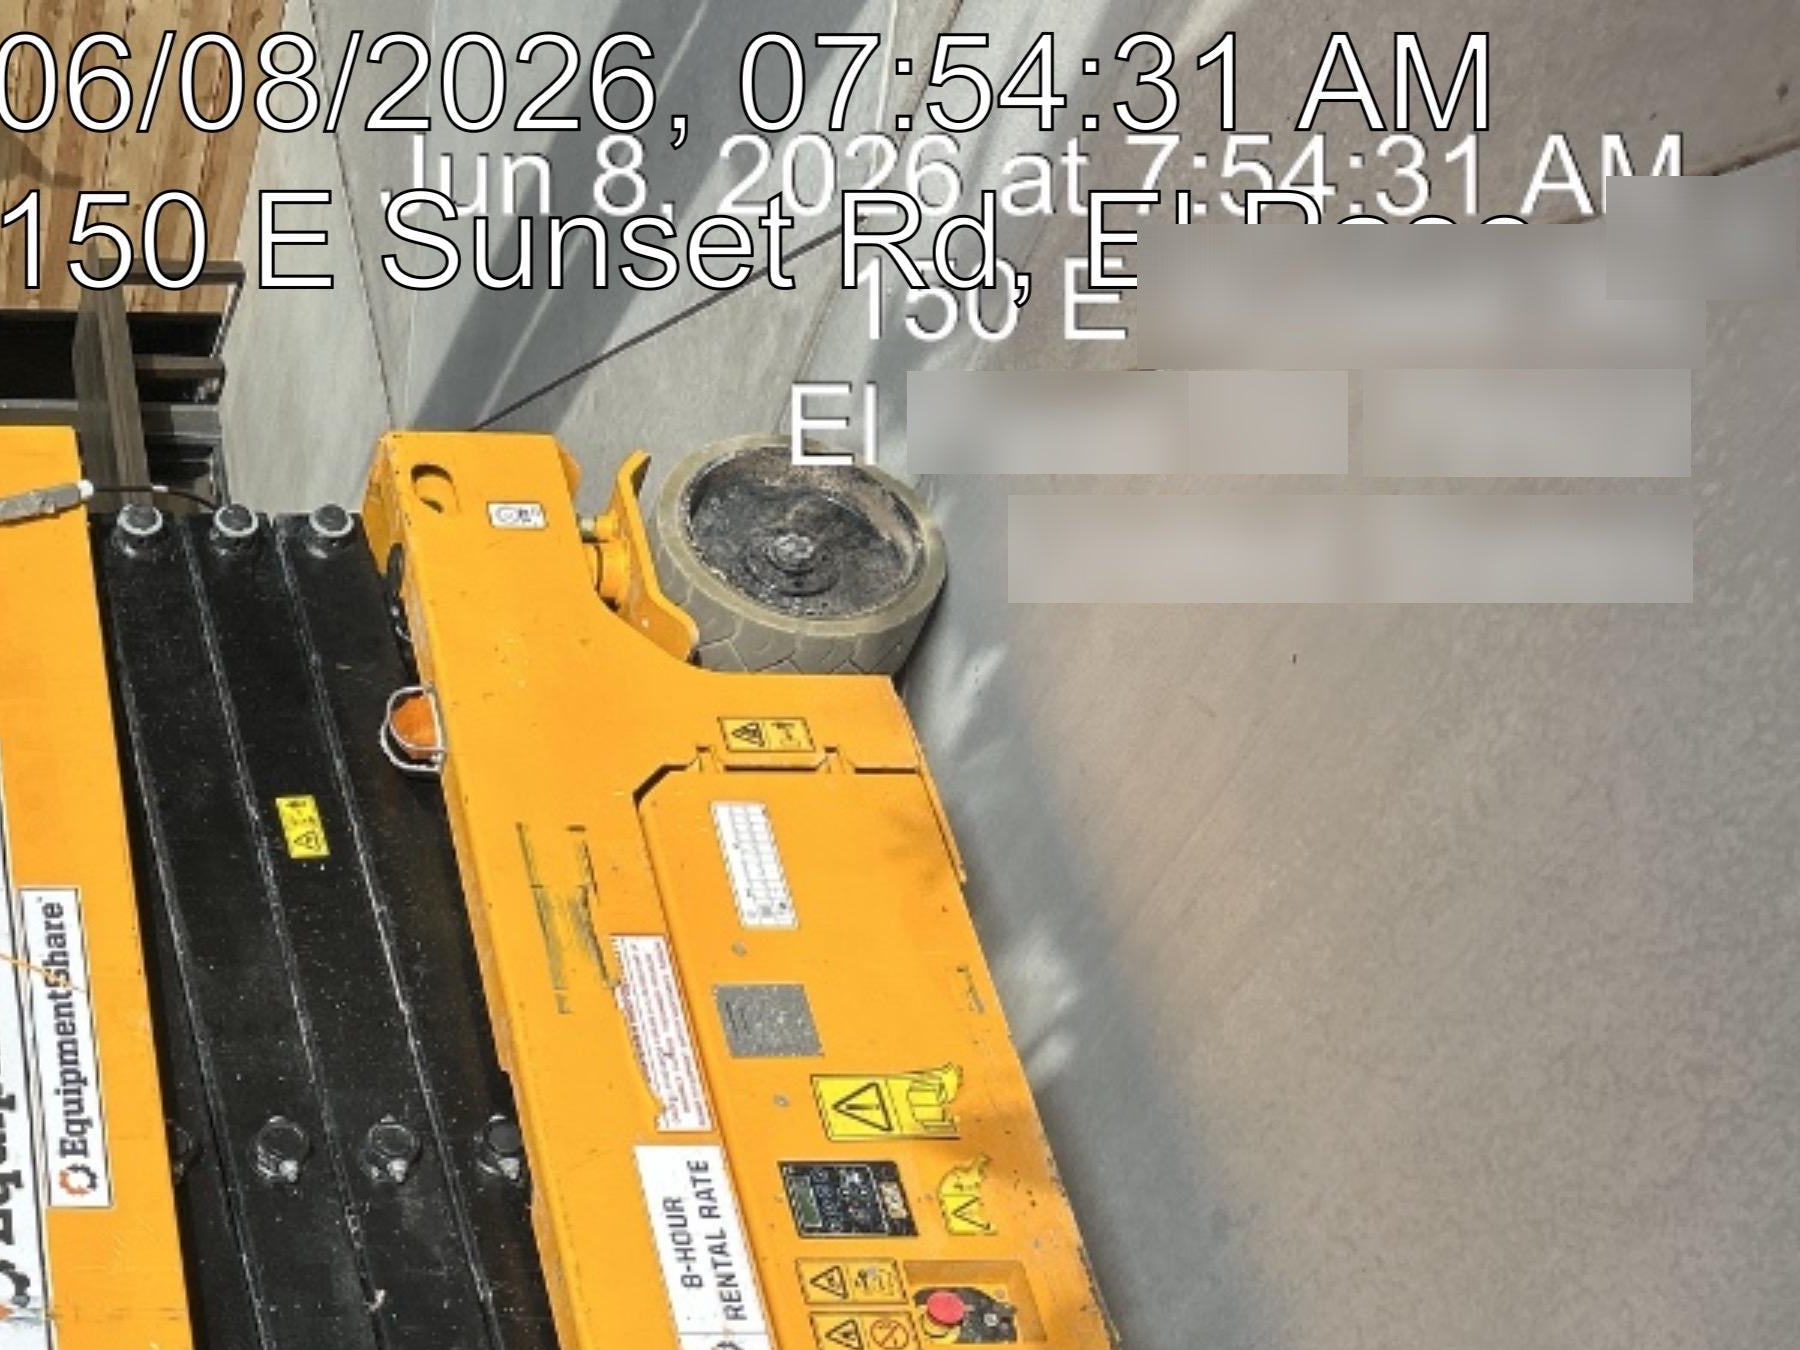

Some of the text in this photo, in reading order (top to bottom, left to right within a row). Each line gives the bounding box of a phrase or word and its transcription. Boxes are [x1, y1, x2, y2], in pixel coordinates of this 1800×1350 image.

[36, 900, 91, 1158] EquipmentShare
[662, 1195, 704, 1288] 8-HOUR
[688, 1158, 748, 1320] RENTAL RATE
